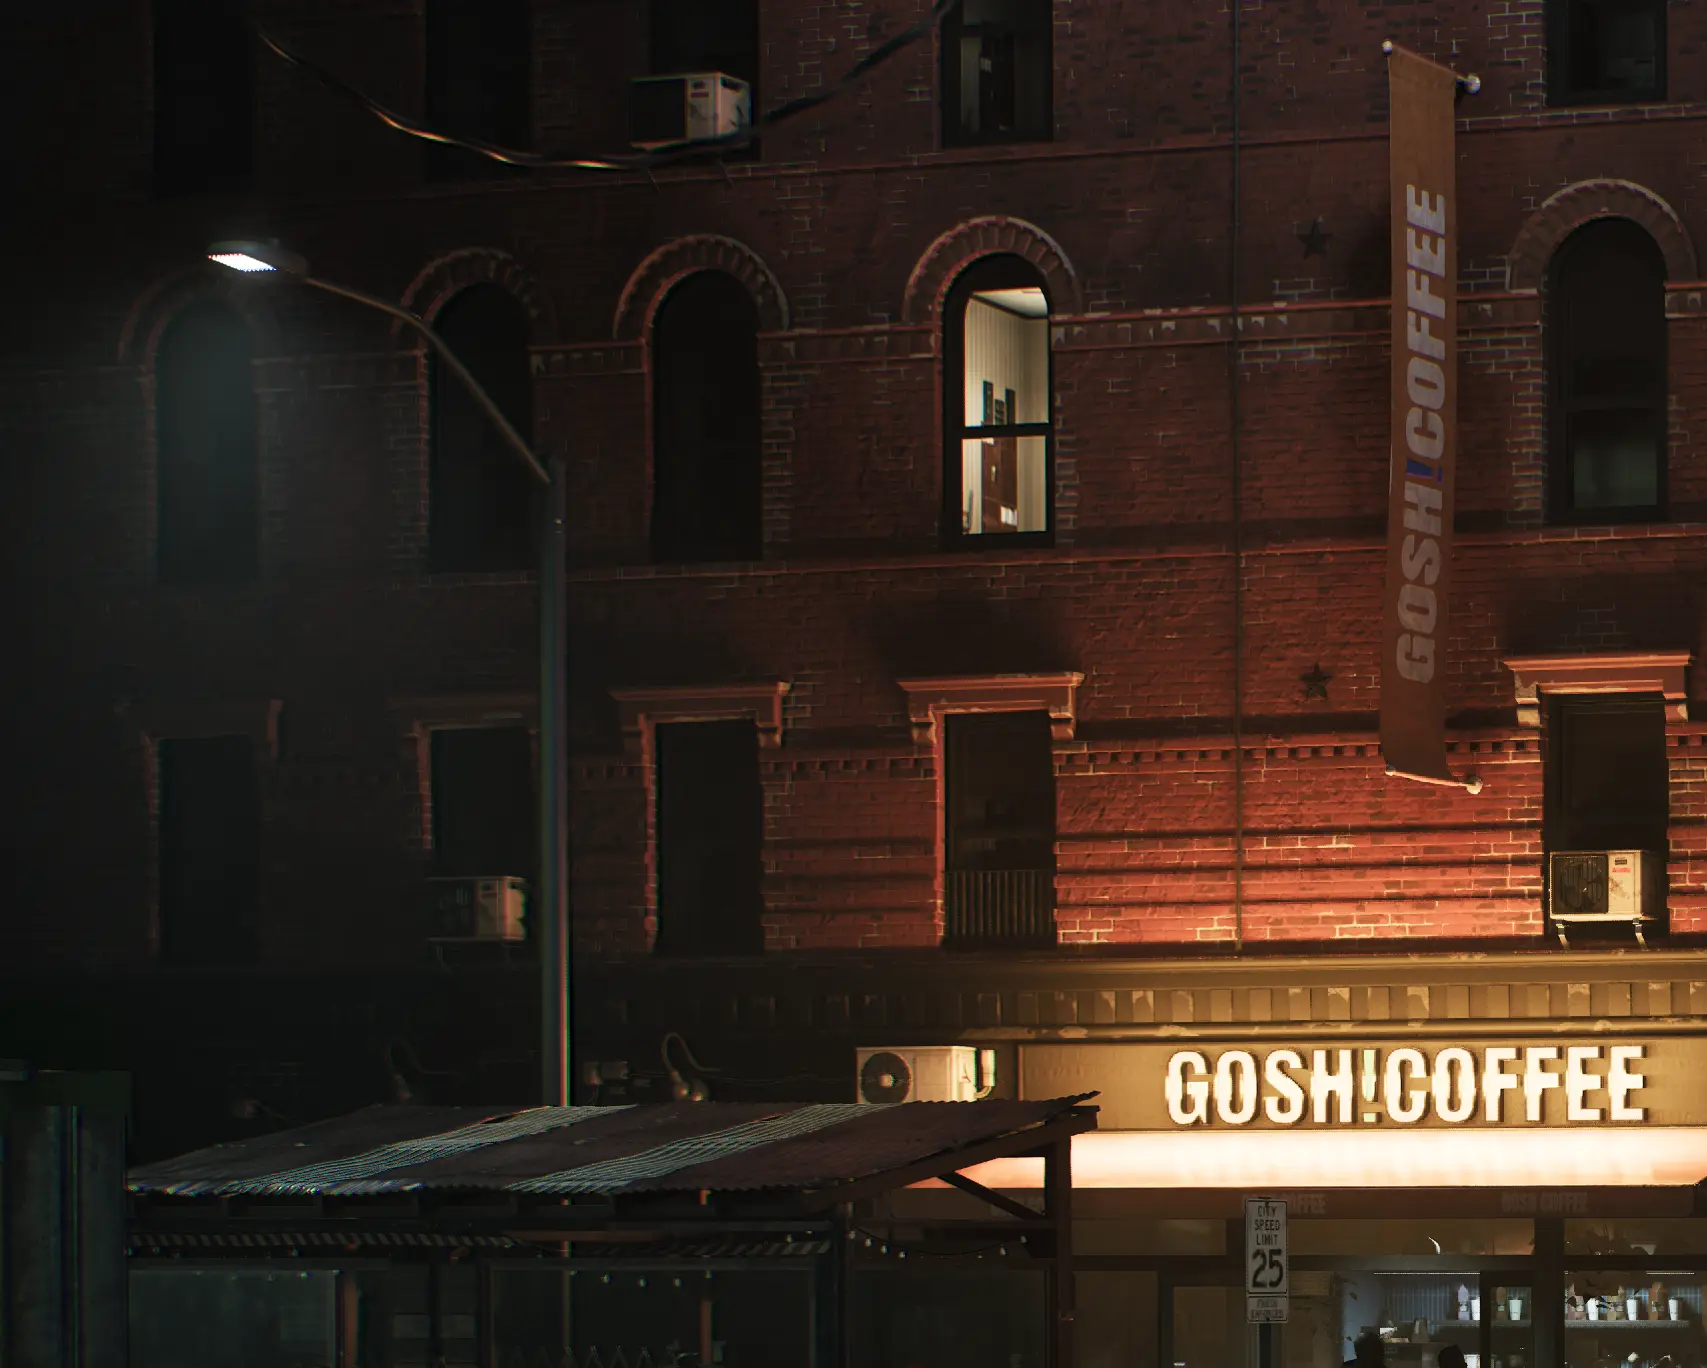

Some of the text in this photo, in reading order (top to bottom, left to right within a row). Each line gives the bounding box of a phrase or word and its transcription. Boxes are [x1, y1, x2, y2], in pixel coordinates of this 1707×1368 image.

[1257, 1205, 1277, 1217] CITY
[1254, 1220, 1281, 1231] SPEED
[1256, 1234, 1278, 1246] LIMIT
[1252, 1249, 1283, 1288] 25
